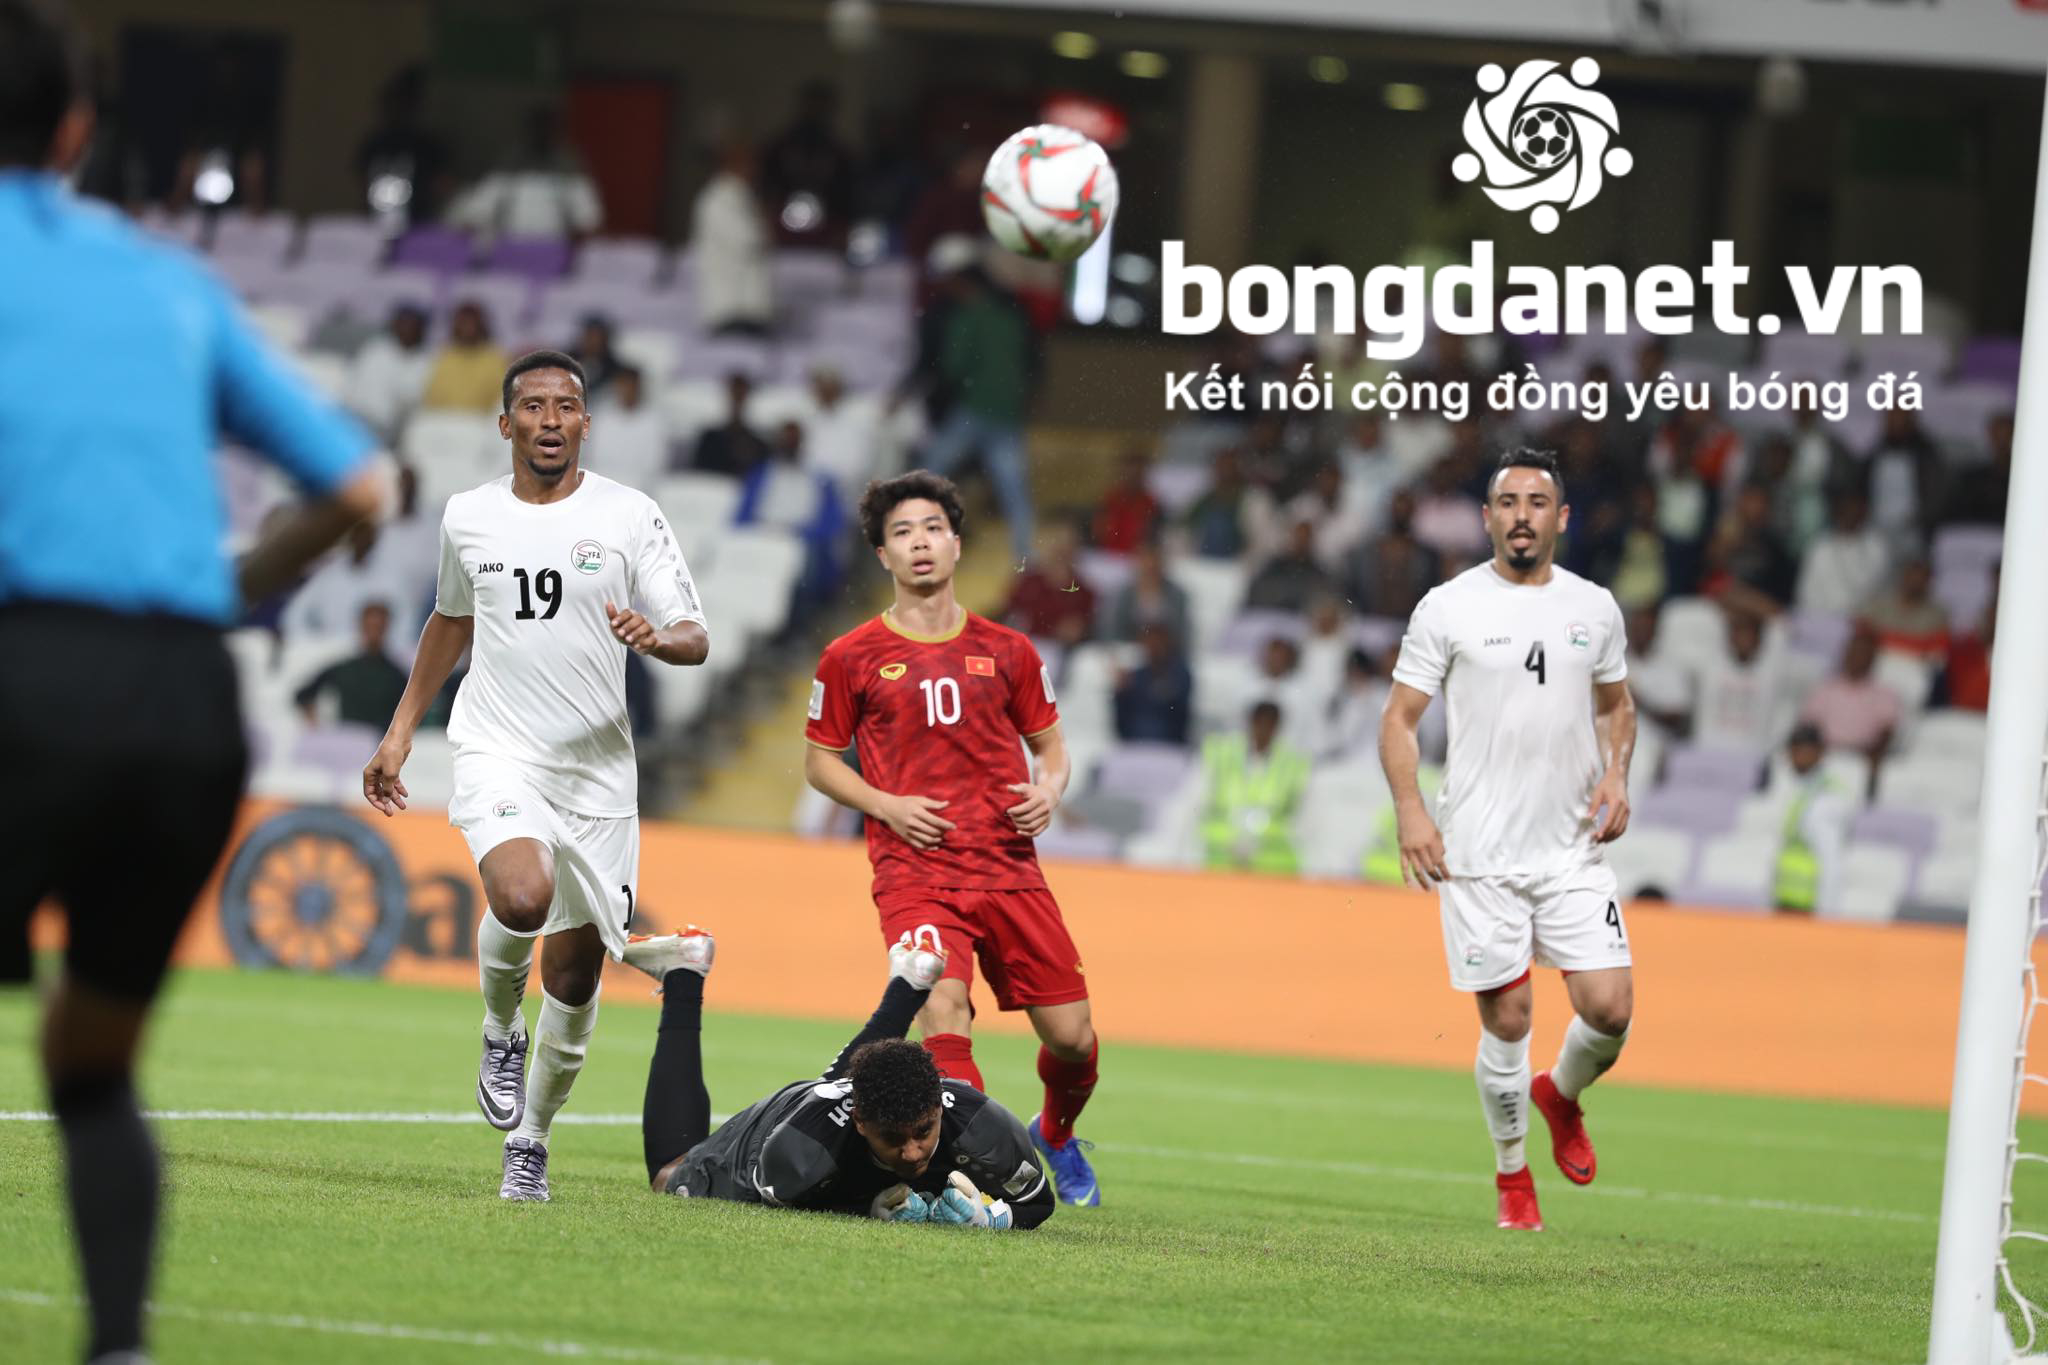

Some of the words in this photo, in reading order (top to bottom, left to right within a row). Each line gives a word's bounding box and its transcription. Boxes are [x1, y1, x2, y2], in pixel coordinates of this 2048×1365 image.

[478, 562, 504, 574] JAKO
[513, 567, 563, 621] 19
[1525, 640, 1546, 685] 4
[919, 677, 962, 727] 10
[1605, 900, 1622, 938] 4
